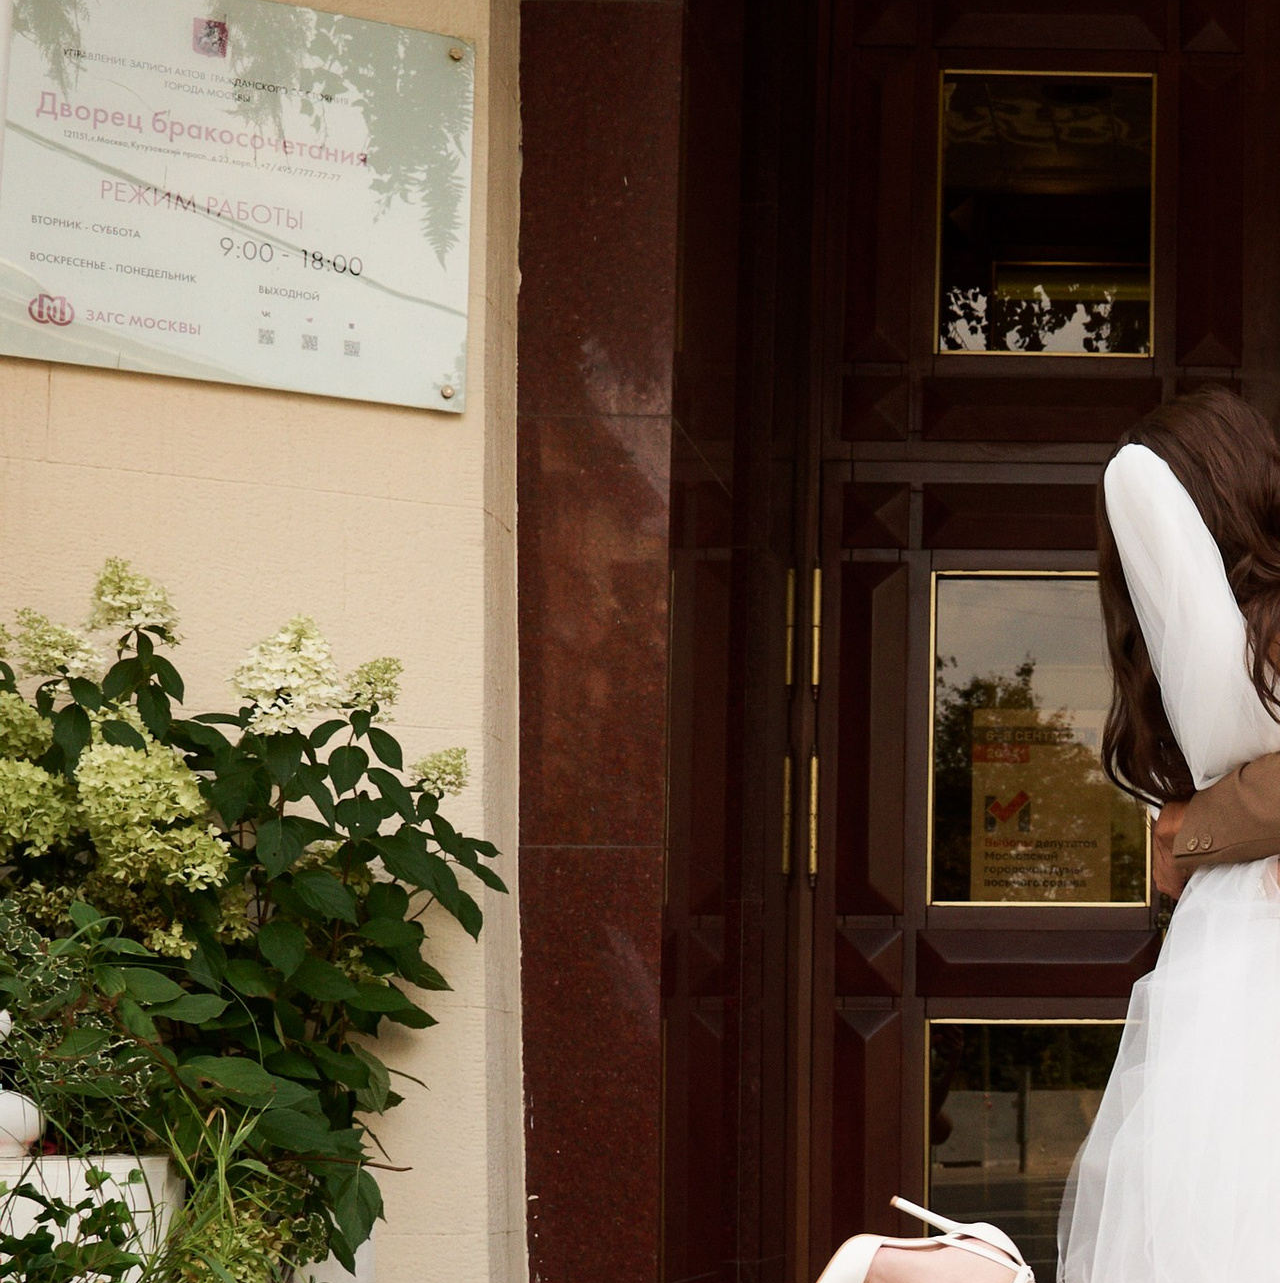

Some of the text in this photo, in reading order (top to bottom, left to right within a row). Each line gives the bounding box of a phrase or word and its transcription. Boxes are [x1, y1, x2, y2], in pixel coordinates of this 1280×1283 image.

[64, 49, 127, 66] УПРАВЛЕНИЕ
[130, 60, 172, 74] ЗАПИСИ
[175, 68, 205, 80] АКТОВ
[165, 81, 251, 103] ГОРОДА МОСКВЫ
[36, 91, 370, 167] Дворец бракосочетания
[101, 180, 304, 230] РЕЖИМ РАБОТЫ
[31, 214, 82, 231] ВТОРНИК
[91, 223, 142, 239] СУББОТА
[29, 251, 106, 271] ВОСКРЕСЕНЬЕ
[115, 263, 198, 284] ПОНЕДЕЛЬНИК
[219, 236, 274, 264] 9:00
[301, 248, 364, 277] 18:00
[258, 284, 320, 302] ВЫХОДНОЙ
[86, 309, 202, 336] ЗАГС МОСКВЫ
[985, 837, 1098, 850] Выборы депутатов
